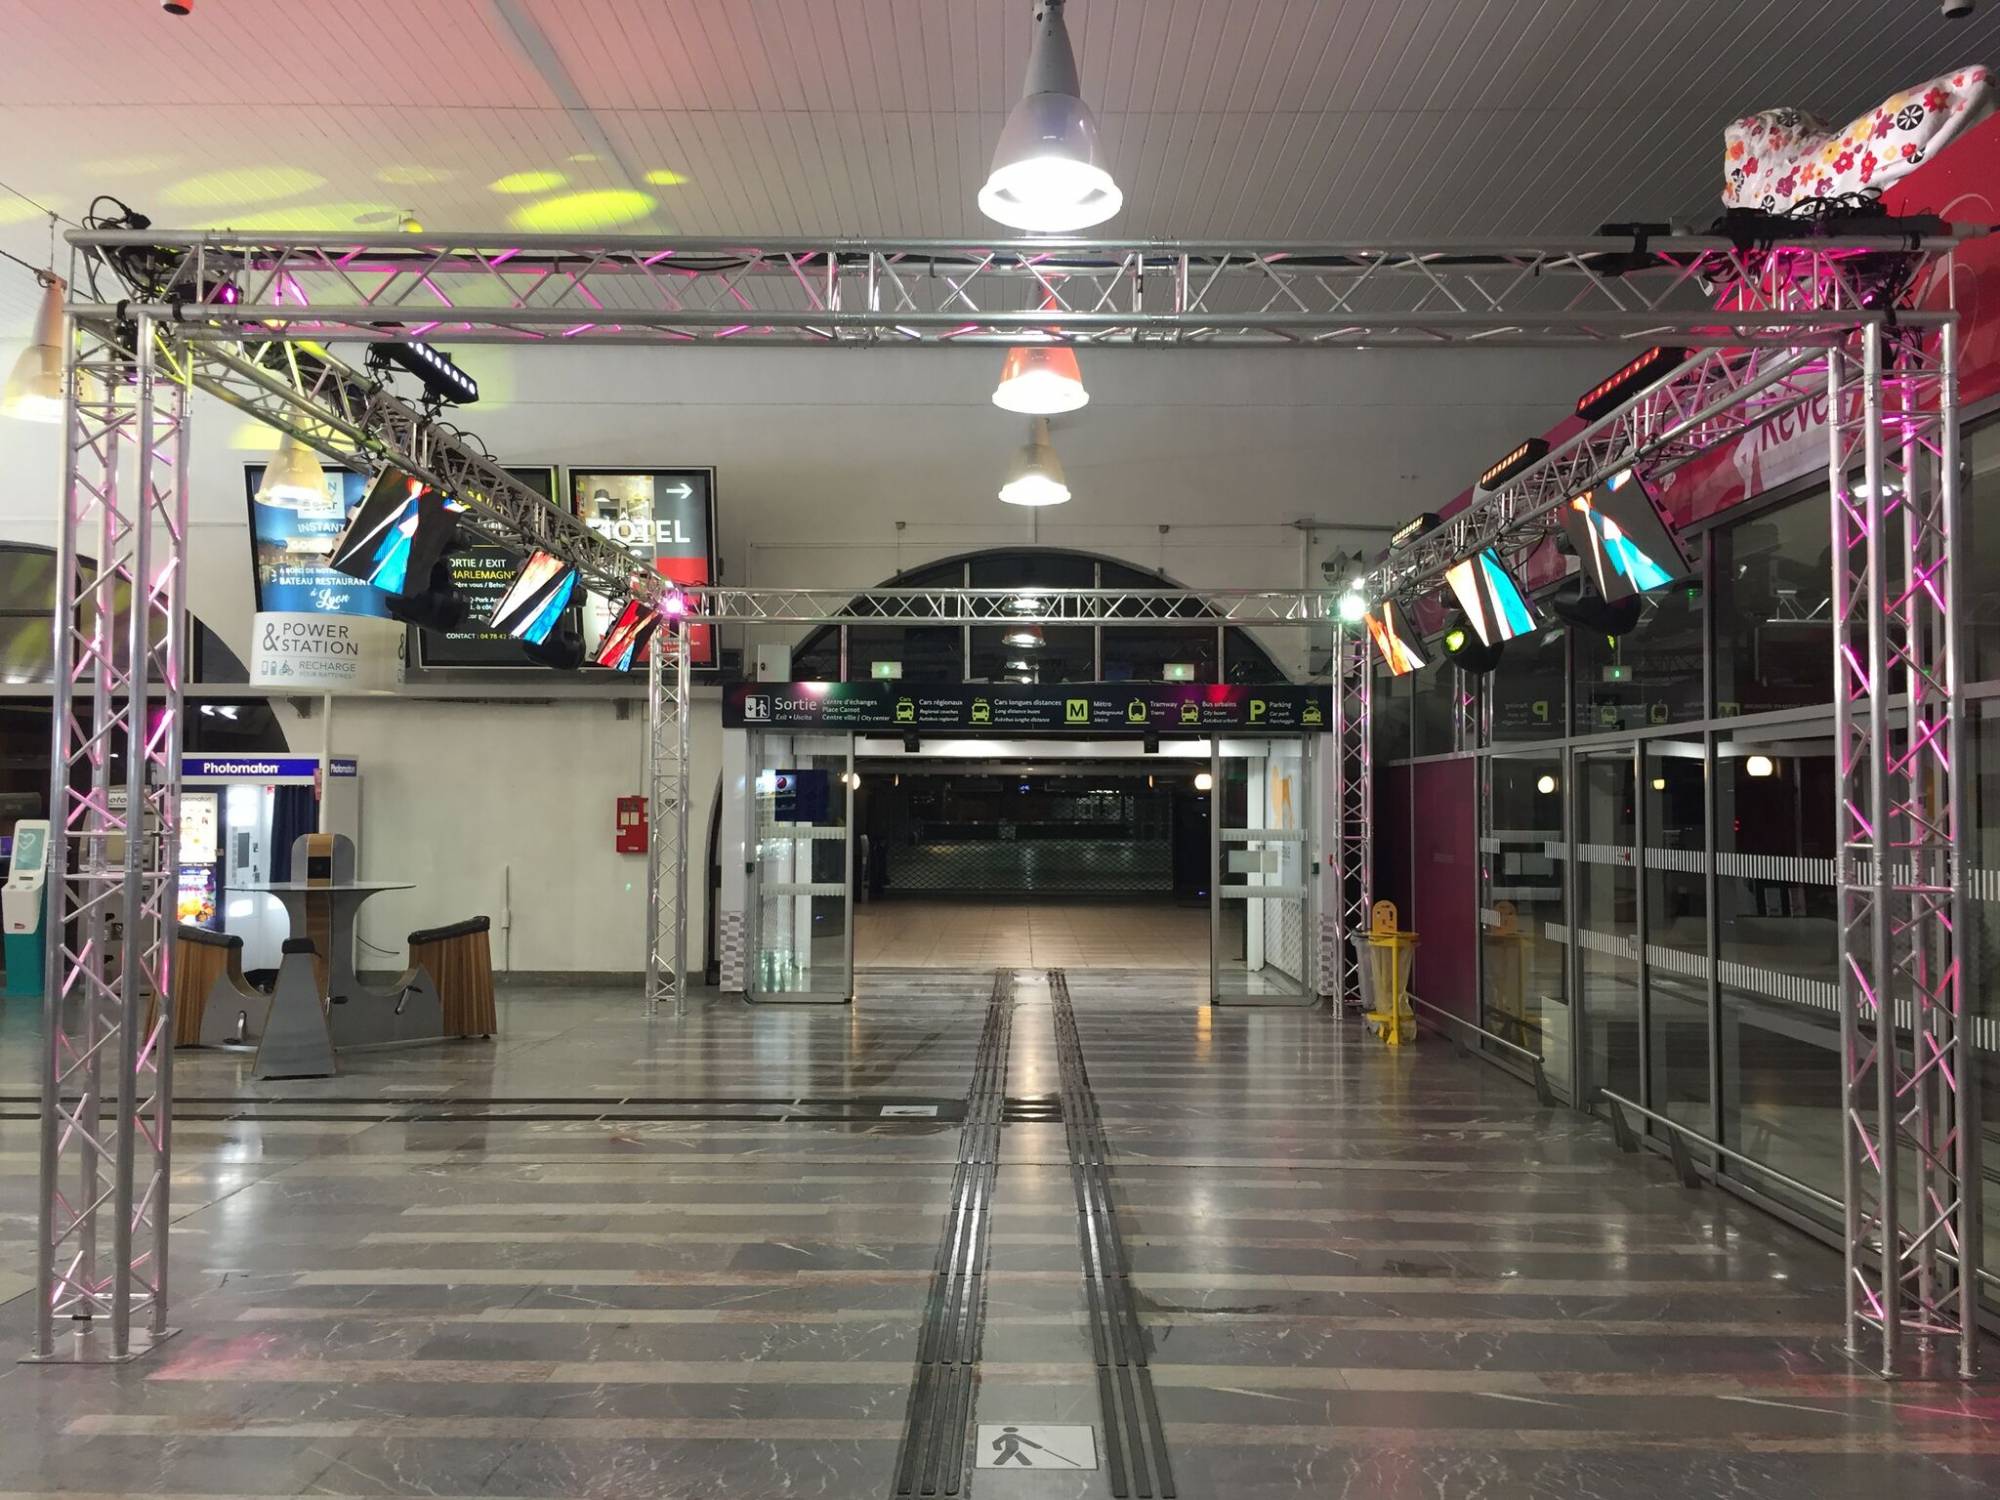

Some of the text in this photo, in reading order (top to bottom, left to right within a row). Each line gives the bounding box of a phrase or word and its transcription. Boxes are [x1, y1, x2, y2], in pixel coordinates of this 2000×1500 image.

[485, 558, 507, 568] EXIT
[452, 570, 517, 579] HARLEMAGN
[279, 577, 371, 586] BATEAU RESTAURANT
[315, 588, 350, 611] Lyon
[283, 622, 349, 639] POWER
[282, 638, 359, 656] STATION
[299, 661, 357, 672] RECHARGE
[774, 697, 817, 711] Sortie
[1269, 701, 1292, 709] Parking
[1250, 700, 1266, 721] P
[822, 713, 843, 721] Centre
[861, 713, 872, 722] City
[203, 762, 278, 774] Photomaton
